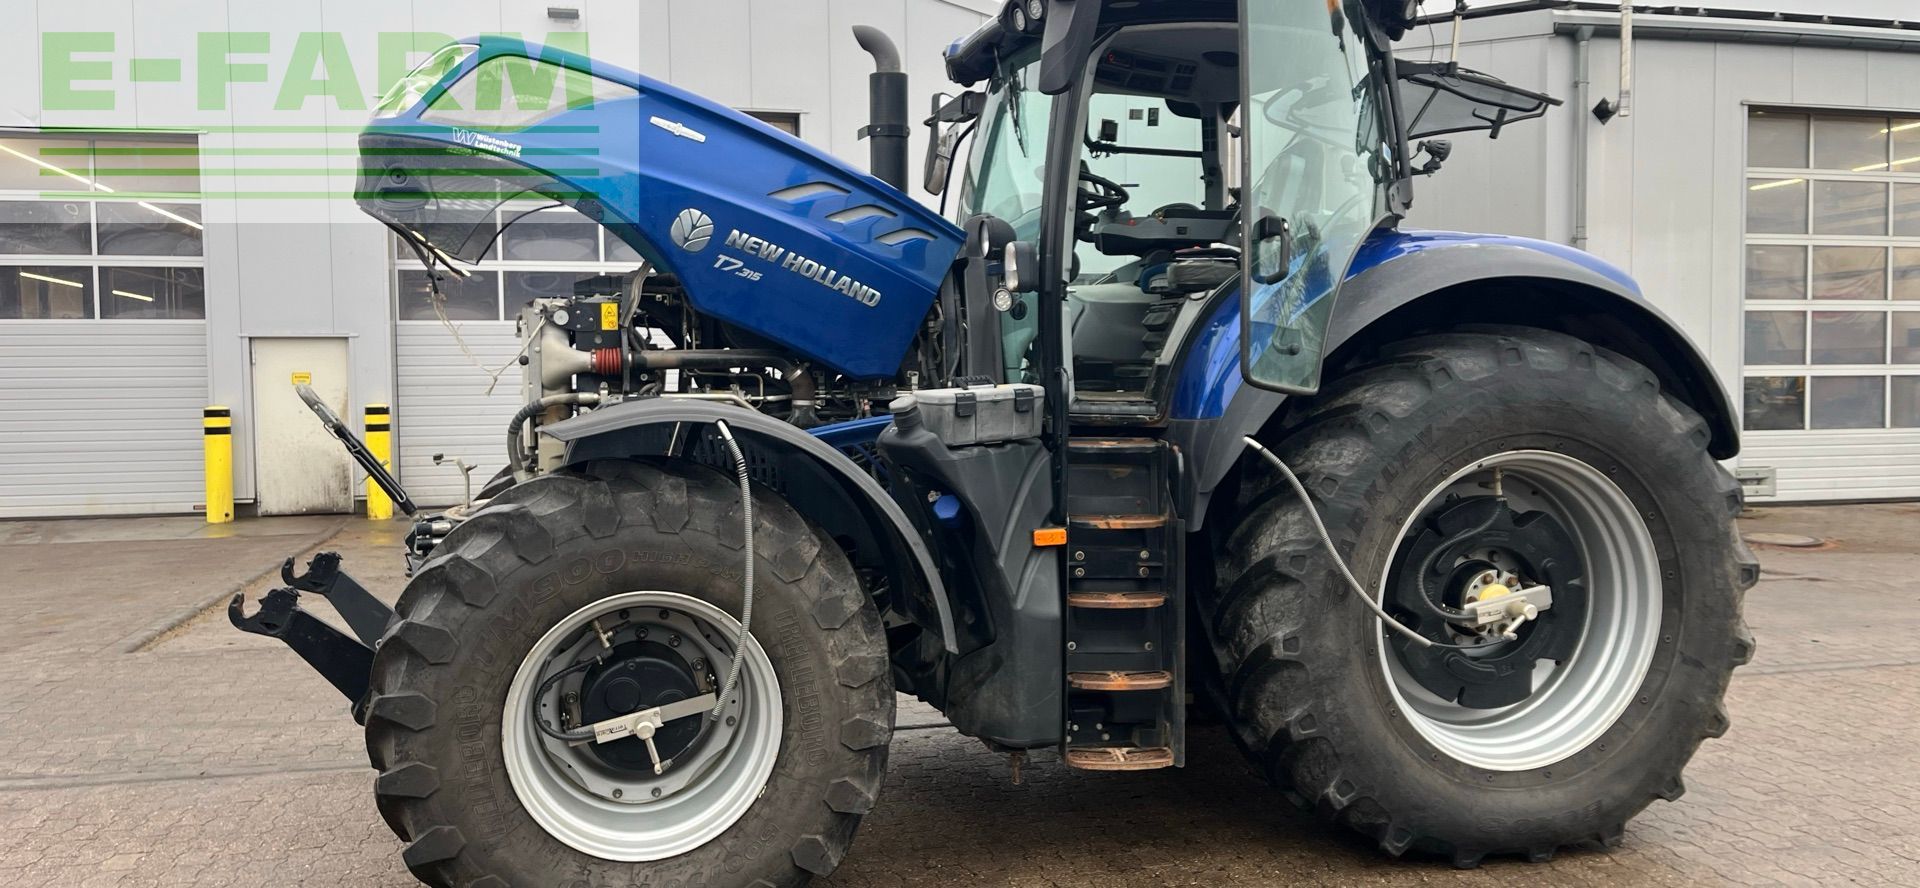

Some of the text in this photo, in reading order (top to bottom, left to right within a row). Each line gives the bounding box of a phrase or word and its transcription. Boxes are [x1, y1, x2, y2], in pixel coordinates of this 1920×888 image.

[475, 141, 521, 158] Landtechnik
[476, 133, 522, 151] Wüstenberg
[712, 254, 763, 282] T7.315
[725, 229, 882, 308] NEW HOLLAND
[774, 606, 827, 768] TRELLEBORG
